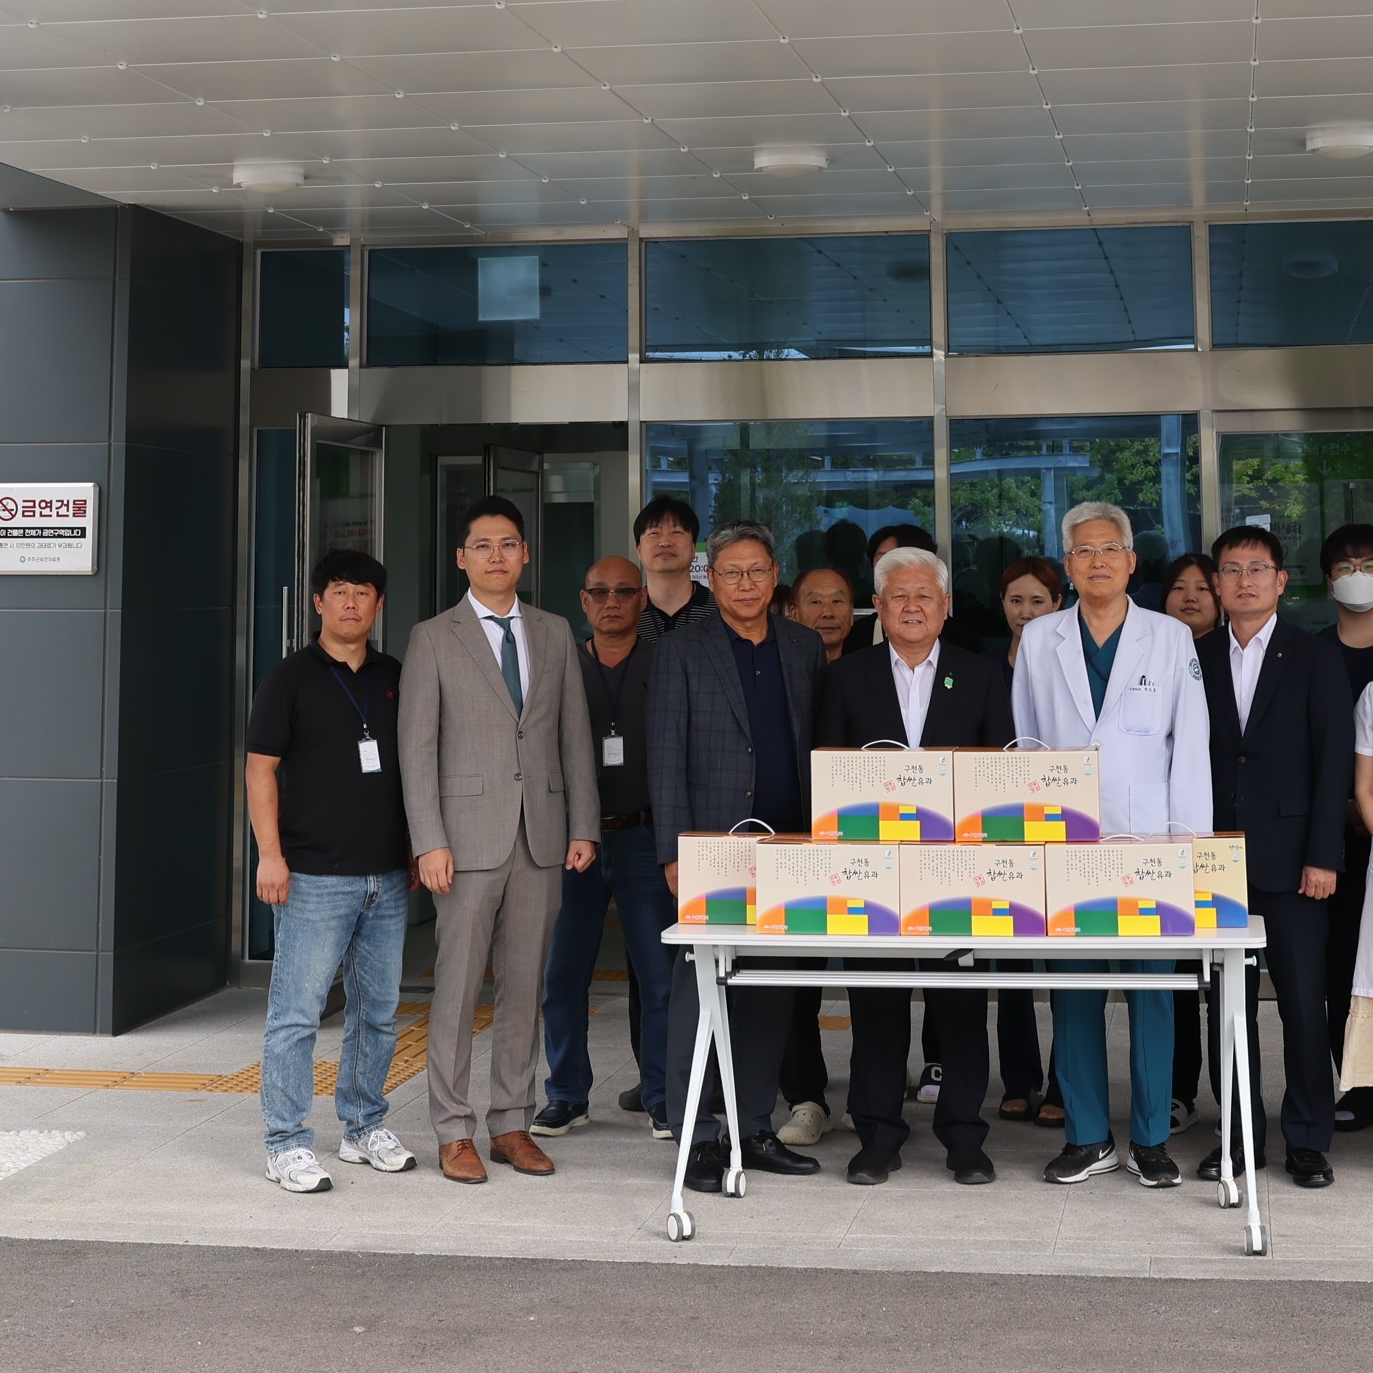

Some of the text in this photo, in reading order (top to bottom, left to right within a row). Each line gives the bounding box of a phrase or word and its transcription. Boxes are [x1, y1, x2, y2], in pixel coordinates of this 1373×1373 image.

[21, 499, 88, 518] 금연건물
[904, 765, 924, 774] 구천동
[1048, 765, 1069, 774] 구천동
[1196, 851, 1216, 861] 구천동
[849, 858, 870, 867] 구천동
[994, 859, 1015, 868] 구천동
[1142, 857, 1163, 867] 구천동
[931, 1066, 943, 1082] C
